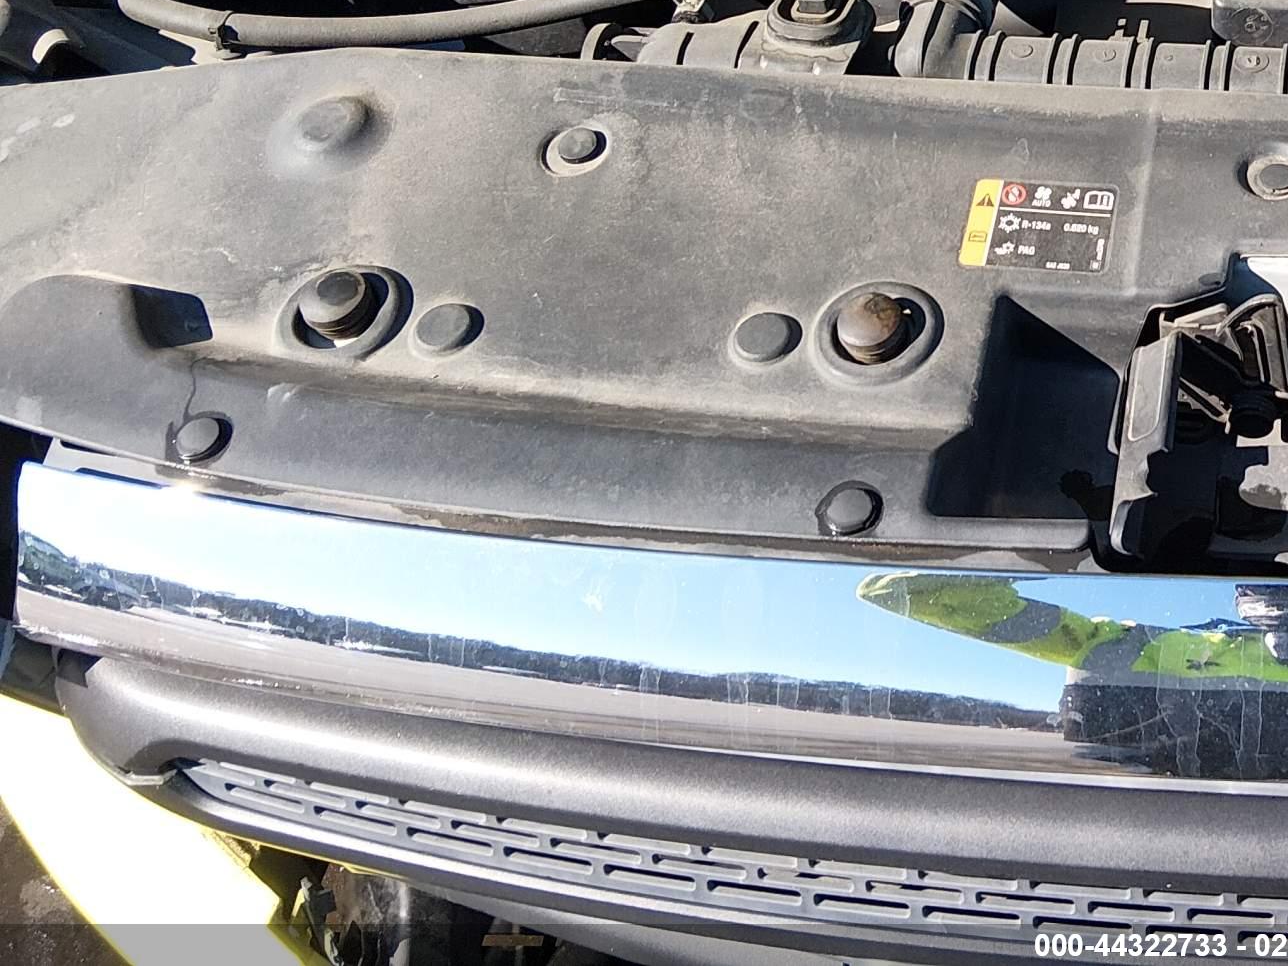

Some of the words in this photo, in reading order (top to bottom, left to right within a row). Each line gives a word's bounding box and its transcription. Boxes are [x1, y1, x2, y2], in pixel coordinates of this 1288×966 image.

[1031, 199, 1051, 207] AUTO
[1021, 220, 1051, 231] R-134a
[1087, 224, 1099, 235] kg
[1017, 245, 1036, 256] PAG
